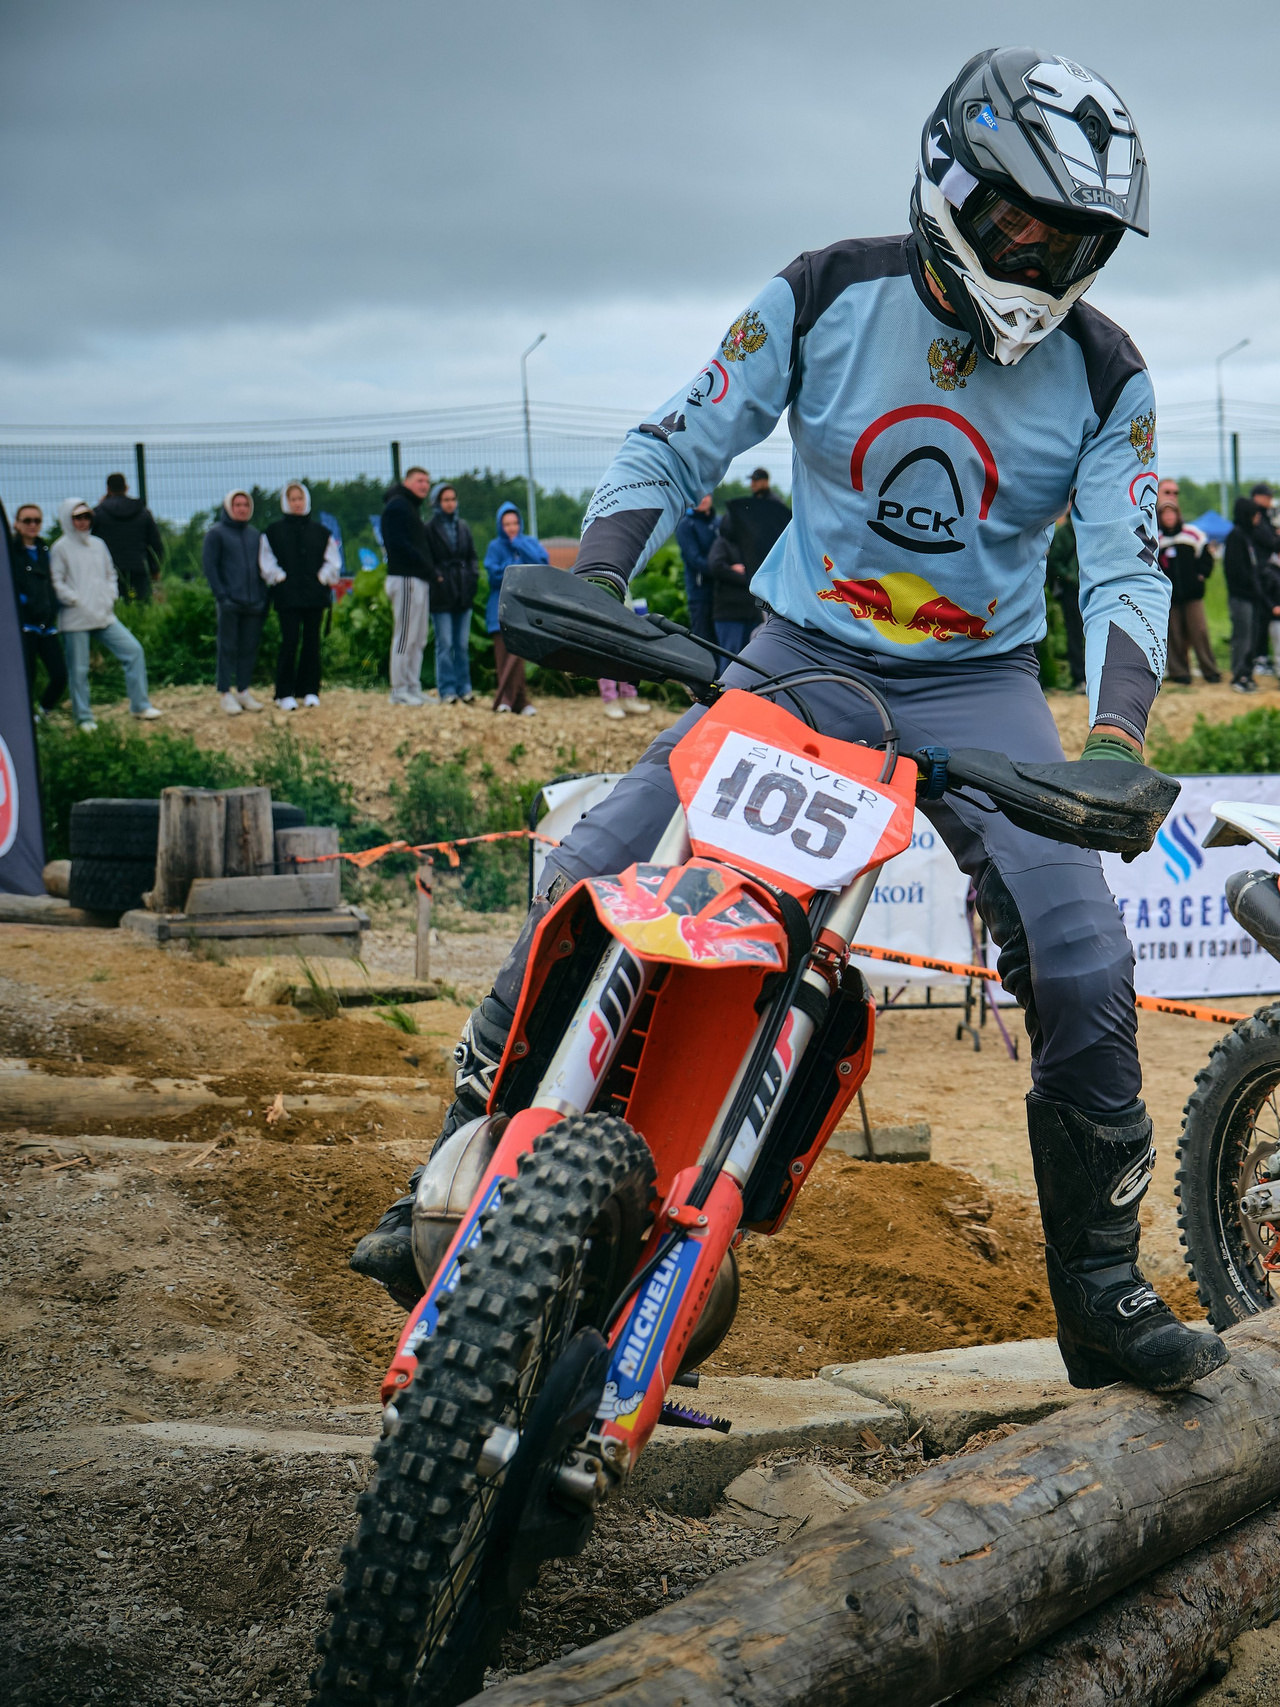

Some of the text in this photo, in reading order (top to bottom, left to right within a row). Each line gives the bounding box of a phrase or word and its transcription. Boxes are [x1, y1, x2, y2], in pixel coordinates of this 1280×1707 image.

[1081, 189, 1126, 214] SHOEI
[877, 500, 958, 538] РСК
[711, 758, 858, 860] 105
[749, 746, 878, 809] SILVER
[677, 1264, 715, 1353] FACTORY
